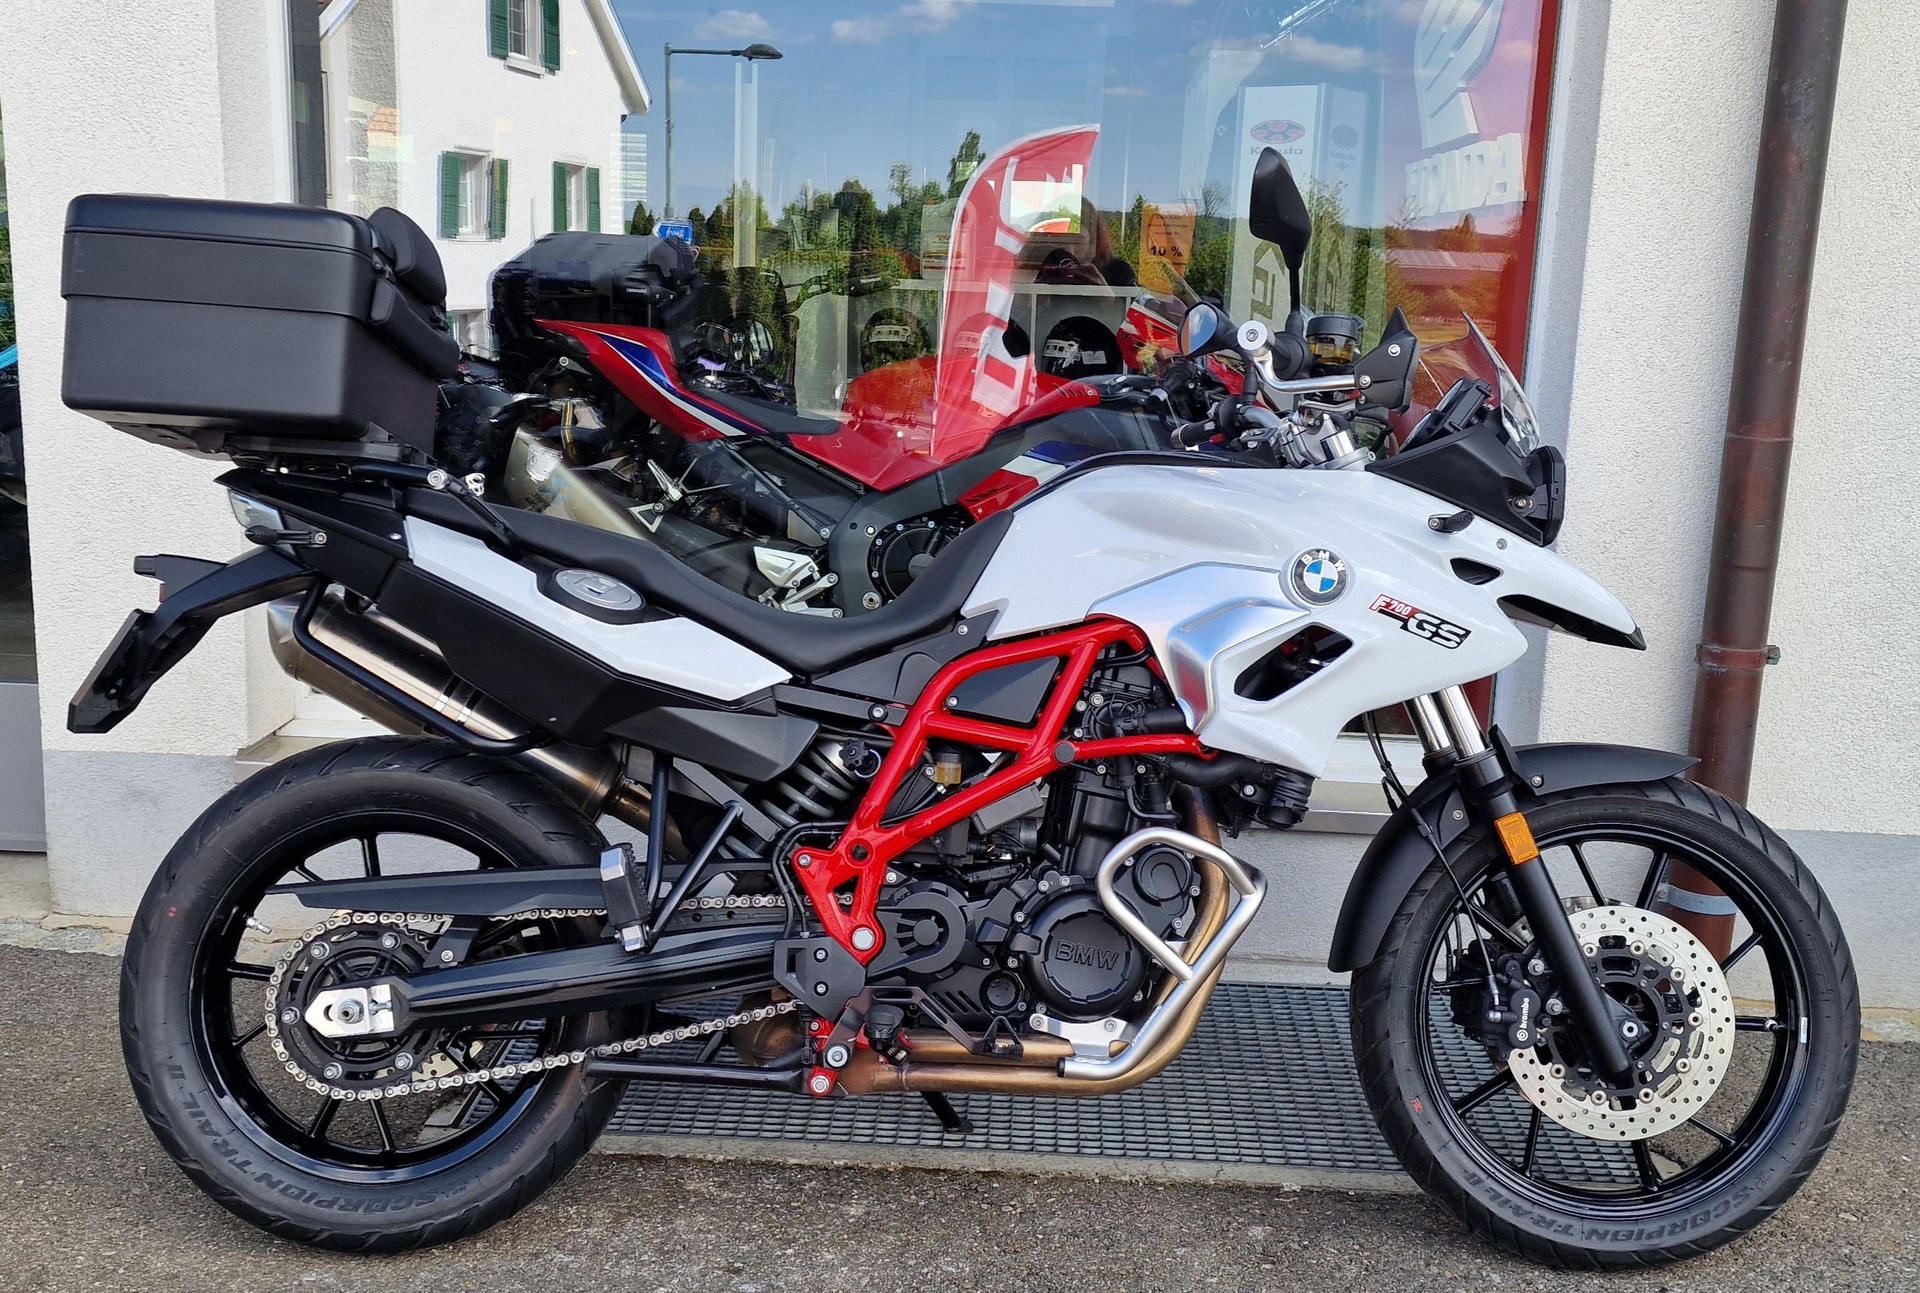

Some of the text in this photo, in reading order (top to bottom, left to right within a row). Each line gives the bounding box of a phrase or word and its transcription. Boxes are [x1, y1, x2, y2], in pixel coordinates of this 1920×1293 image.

[1250, 146, 1303, 155] Kuto
[1406, 133, 1529, 218] HONDA
[1151, 245, 1167, 257] 10
[1301, 550, 1347, 572] BMW
[1055, 940, 1119, 970] BMW
[1519, 997, 1530, 1029] brembo
[182, 1092, 253, 1174] TRAIL
[254, 1172, 437, 1215] SCORPION
[1485, 1186, 1574, 1237] TRAIL
[1584, 1185, 1751, 1243] SCORPION
